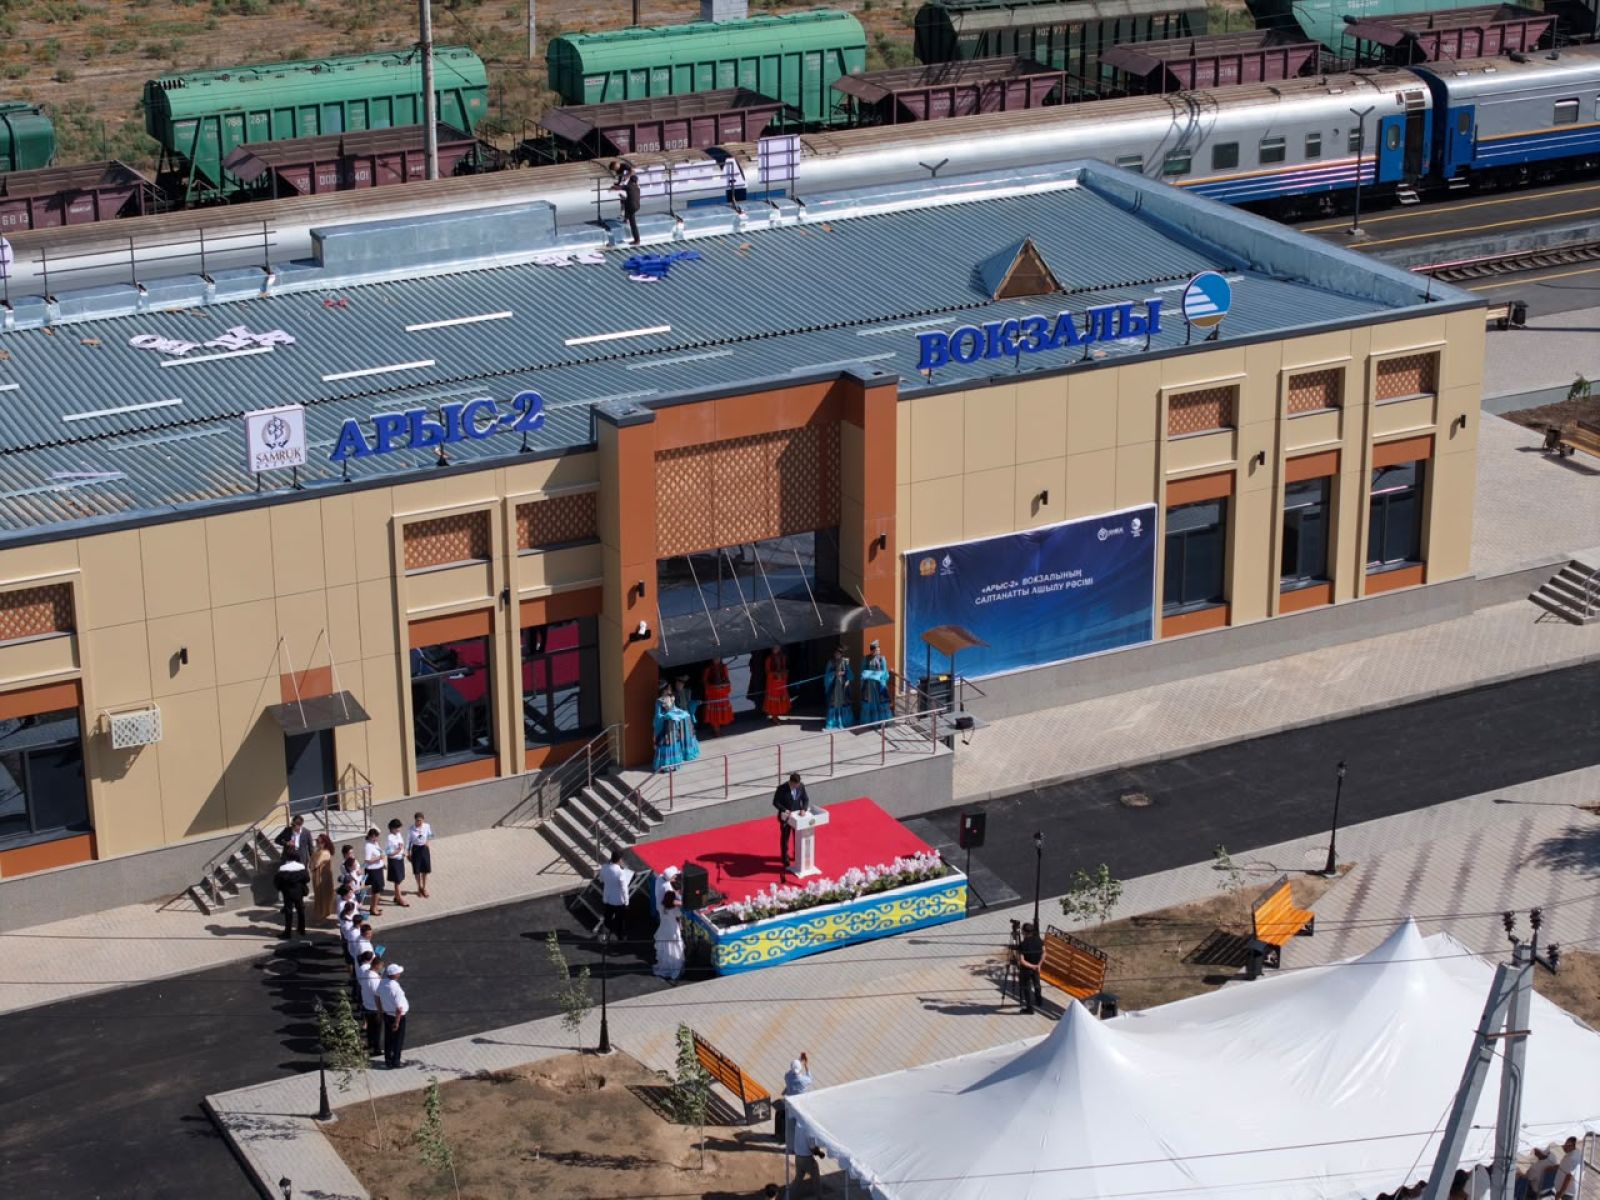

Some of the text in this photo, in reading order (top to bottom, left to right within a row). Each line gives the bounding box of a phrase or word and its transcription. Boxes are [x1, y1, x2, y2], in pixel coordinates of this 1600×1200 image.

[915, 297, 1163, 369] ВОКЗАЛЫ
[329, 389, 545, 461] АРЫС-2
[256, 447, 301, 463] SAMRUK
[974, 588, 1030, 605] САЛТАНАТТЫ
